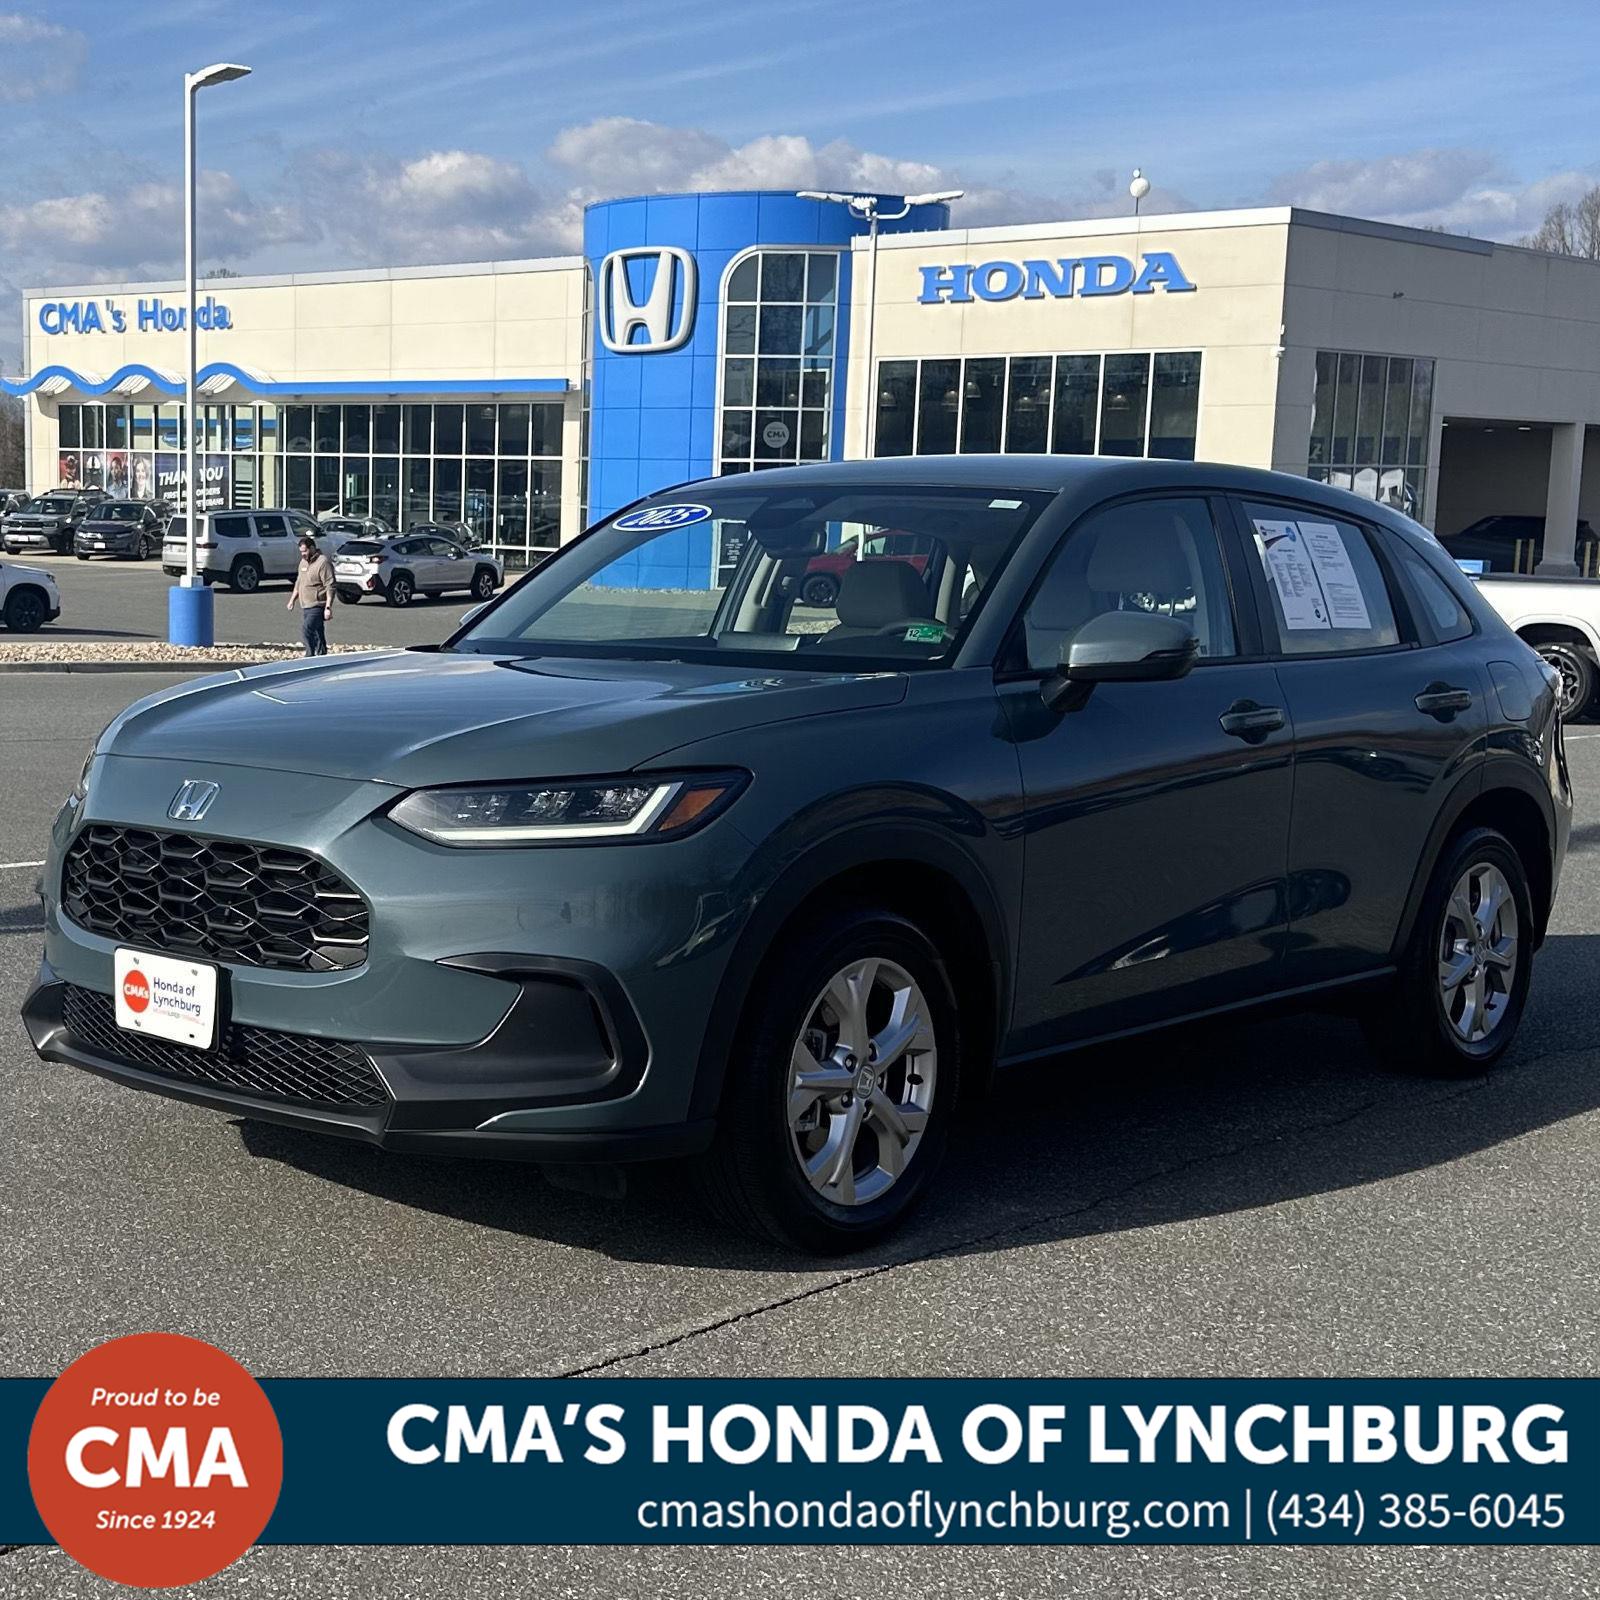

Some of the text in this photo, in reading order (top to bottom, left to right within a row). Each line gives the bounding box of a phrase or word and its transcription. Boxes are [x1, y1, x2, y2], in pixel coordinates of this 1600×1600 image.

[917, 251, 1198, 305] HONDA
[39, 299, 126, 335] CMA's
[766, 430, 787, 439] CMA
[199, 466, 224, 483] YOU
[620, 508, 703, 527] 2025
[153, 977, 196, 998] Honda of
[153, 992, 202, 1017] Lynchburg
